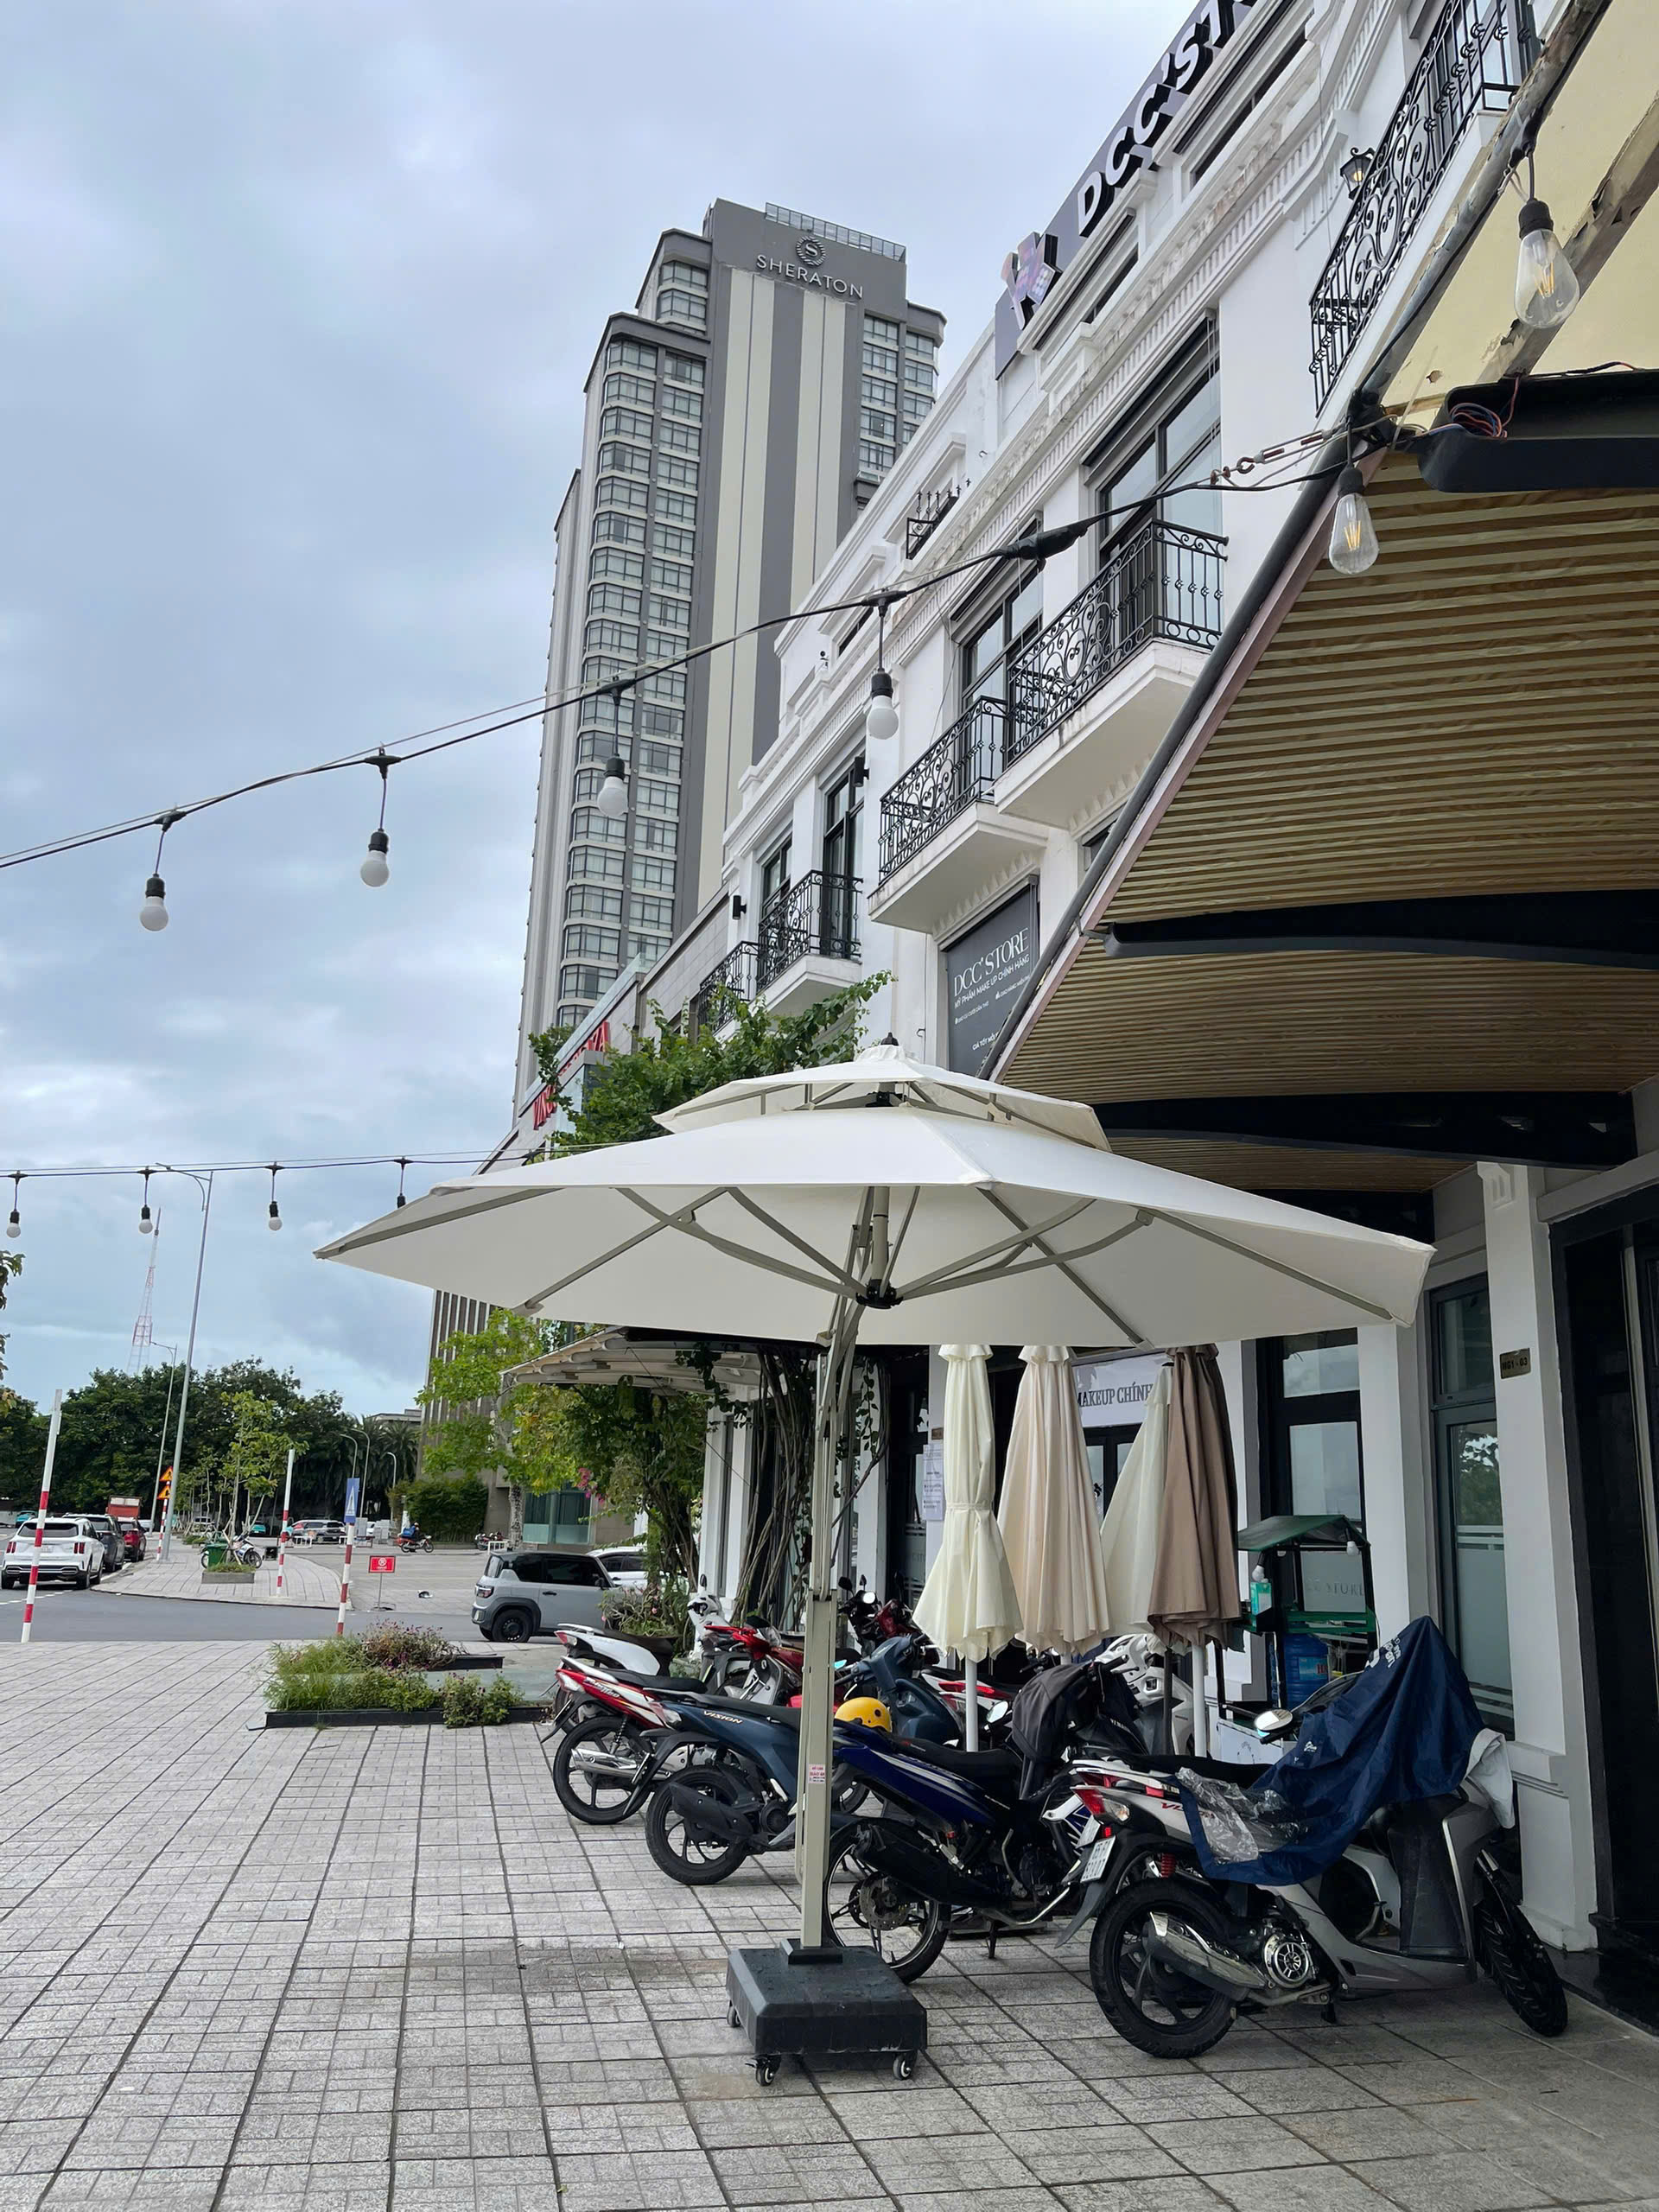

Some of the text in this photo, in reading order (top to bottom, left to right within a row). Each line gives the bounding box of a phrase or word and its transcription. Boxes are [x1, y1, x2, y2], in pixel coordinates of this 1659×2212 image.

[1077, 0, 1244, 237] DCC'ST
[756, 253, 863, 299] SHERATON
[976, 980, 990, 995] MAKE
[990, 975, 997, 986] UP
[703, 1710, 743, 1724] VISION
